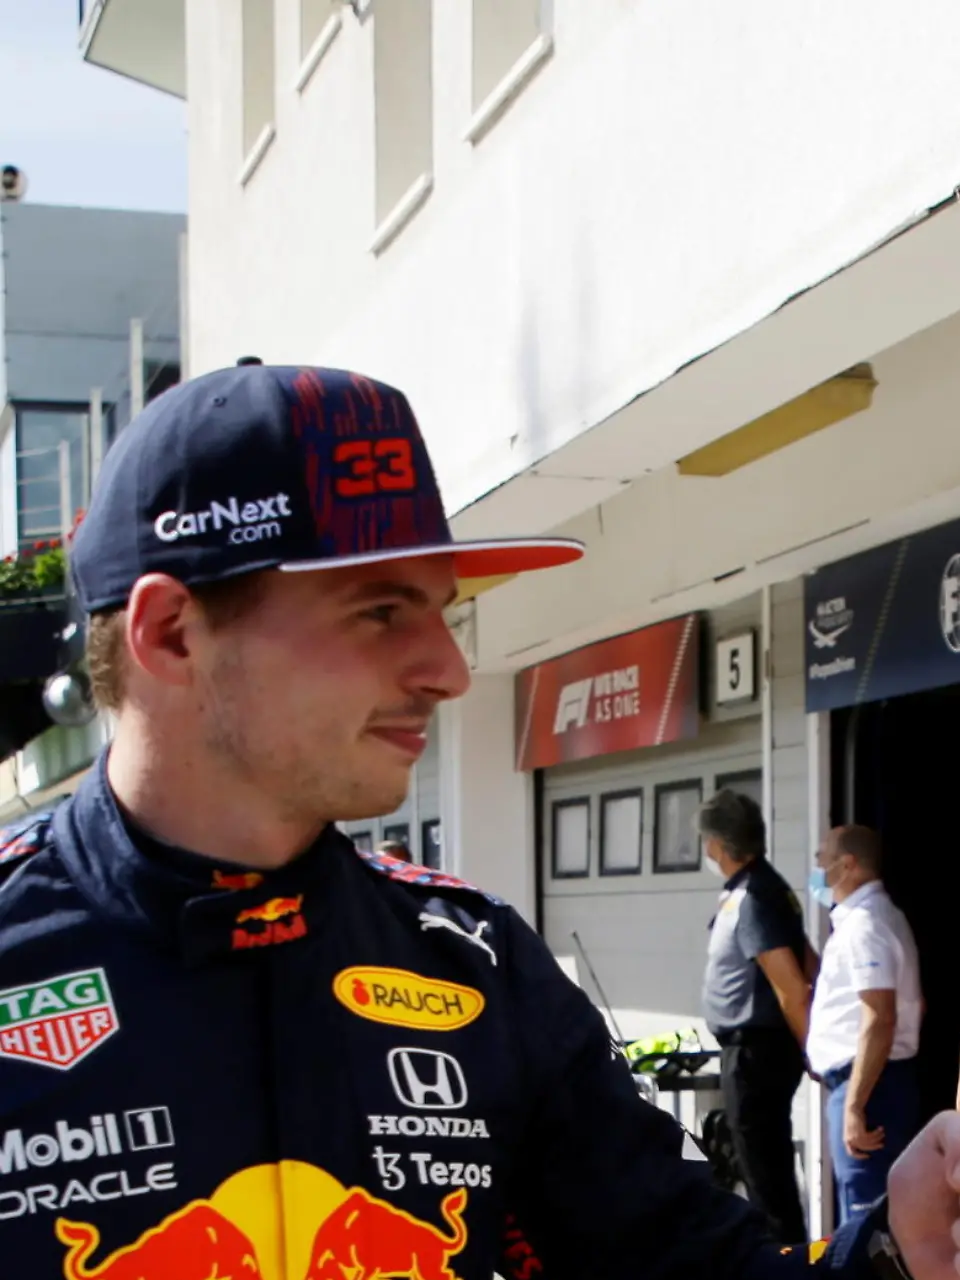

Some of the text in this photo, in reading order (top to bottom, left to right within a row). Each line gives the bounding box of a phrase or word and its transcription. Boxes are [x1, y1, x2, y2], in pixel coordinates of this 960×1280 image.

[333, 438, 416, 496] 33
[154, 493, 292, 542] CarNext
[729, 648, 741, 690] 5
[596, 691, 640, 722] AS ONE
[0, 977, 99, 1020] TAG
[373, 983, 464, 1015] RAUCH
[1, 1010, 110, 1062] HEUER
[367, 1114, 490, 1139] HONDA
[409, 1152, 492, 1188] Tezos
[0, 1162, 178, 1221] ORACLE
